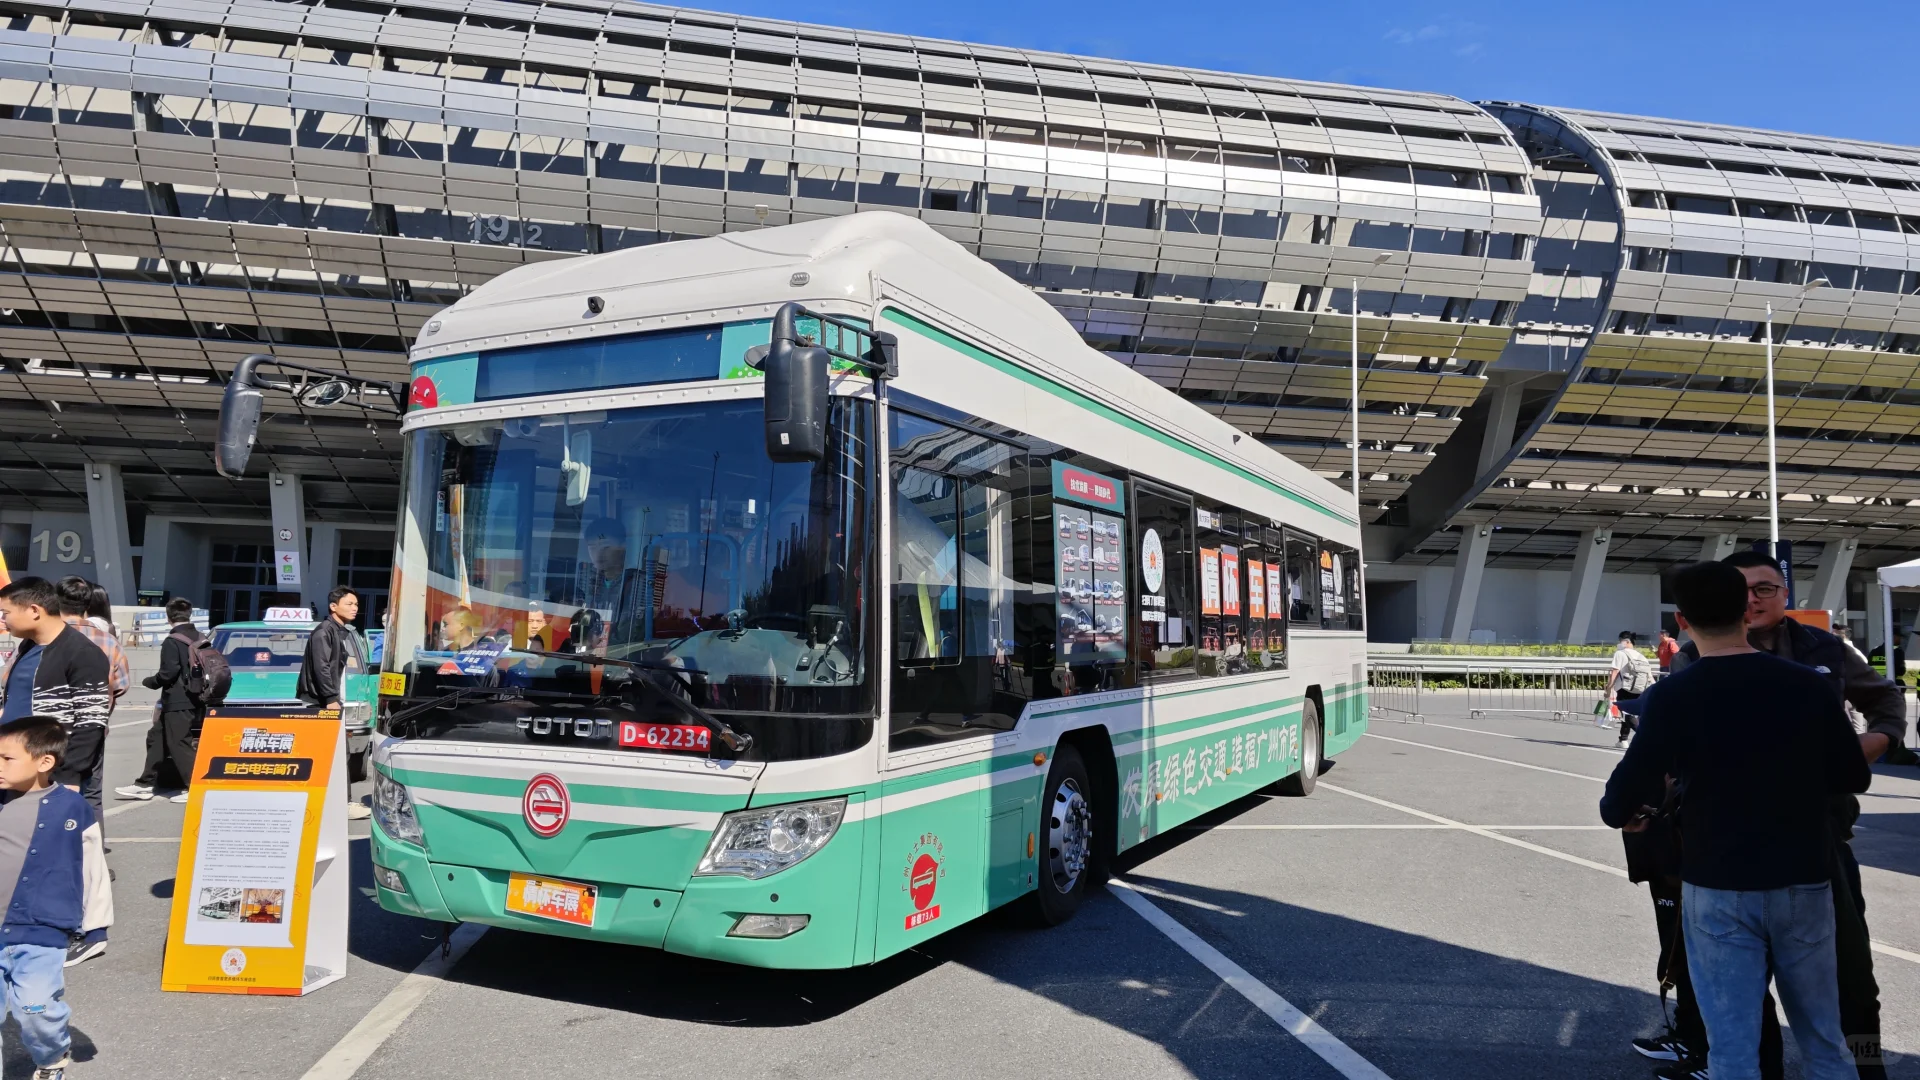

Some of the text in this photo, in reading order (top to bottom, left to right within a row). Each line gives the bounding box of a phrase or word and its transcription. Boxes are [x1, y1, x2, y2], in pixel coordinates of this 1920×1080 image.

[467, 213, 543, 246] 19.2
[1202, 554, 1281, 614] 情怀车展
[270, 609, 309, 620] TAXI
[240, 736, 294, 750] 情怀车展
[623, 725, 709, 749] D-62234
[223, 763, 300, 776] 复古电车简介
